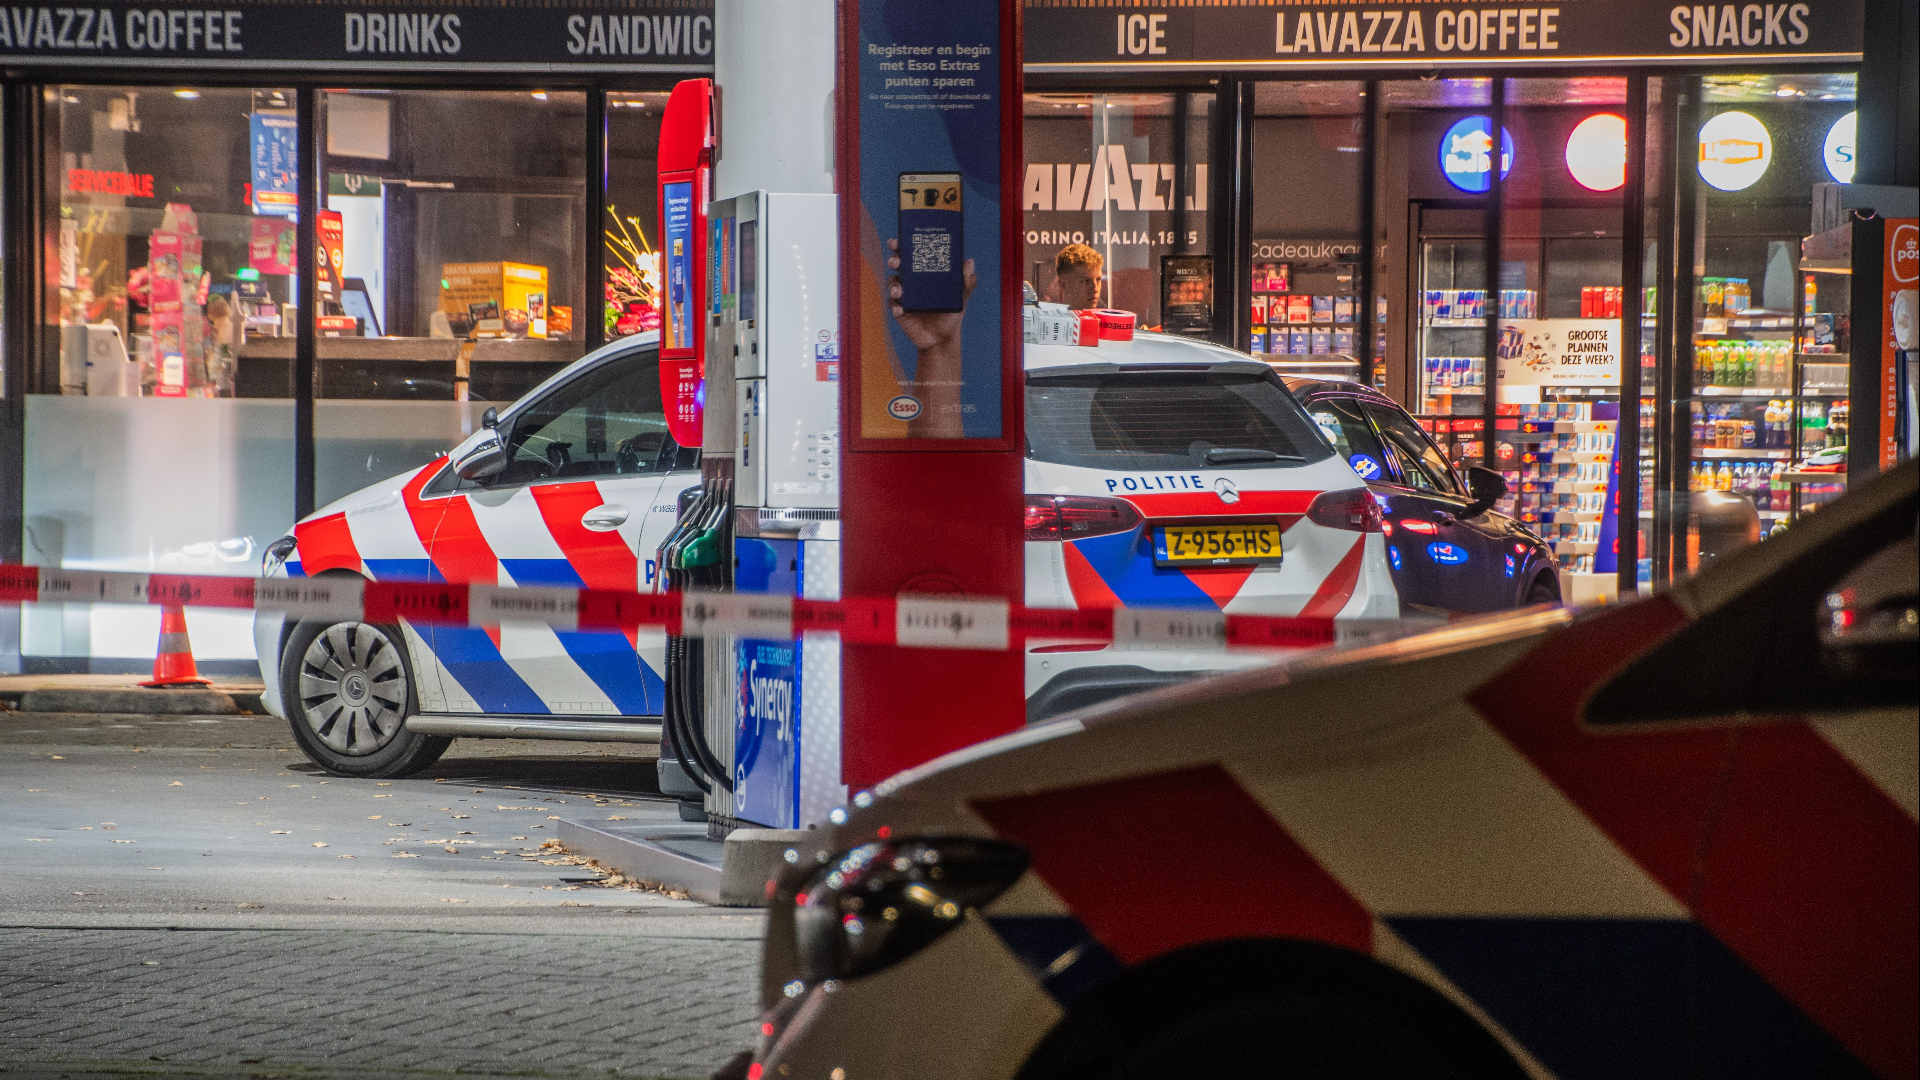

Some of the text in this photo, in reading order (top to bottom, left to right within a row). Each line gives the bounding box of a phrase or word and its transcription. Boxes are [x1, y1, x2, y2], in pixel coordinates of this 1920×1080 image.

[125, 8, 243, 51] COFFEE
[345, 12, 462, 54] DRINKS
[1117, 13, 1167, 55] ICE
[1275, 7, 1559, 54] LAVAZZA COFFEE
[1669, 4, 1810, 49] SNACKS
[567, 14, 712, 56] SANDWIC
[868, 43, 991, 58] Registreer en begin
[879, 60, 980, 71] met Esso Extras
[885, 77, 975, 90] punten sparen
[69, 168, 154, 198] SERVICEBALIE
[1023, 230, 1198, 246] ORINO, ITALIA, 185
[1568, 330, 1608, 341] GROOTSE
[1567, 342, 1608, 353] PLANNEN
[1561, 354, 1615, 365] DEZE WEEK?
[893, 402, 976, 413] Esso extras
[1105, 475, 1205, 492] POLITIE
[1171, 529, 1272, 556] Z-956-HS
[1157, 547, 1167, 555] NL
